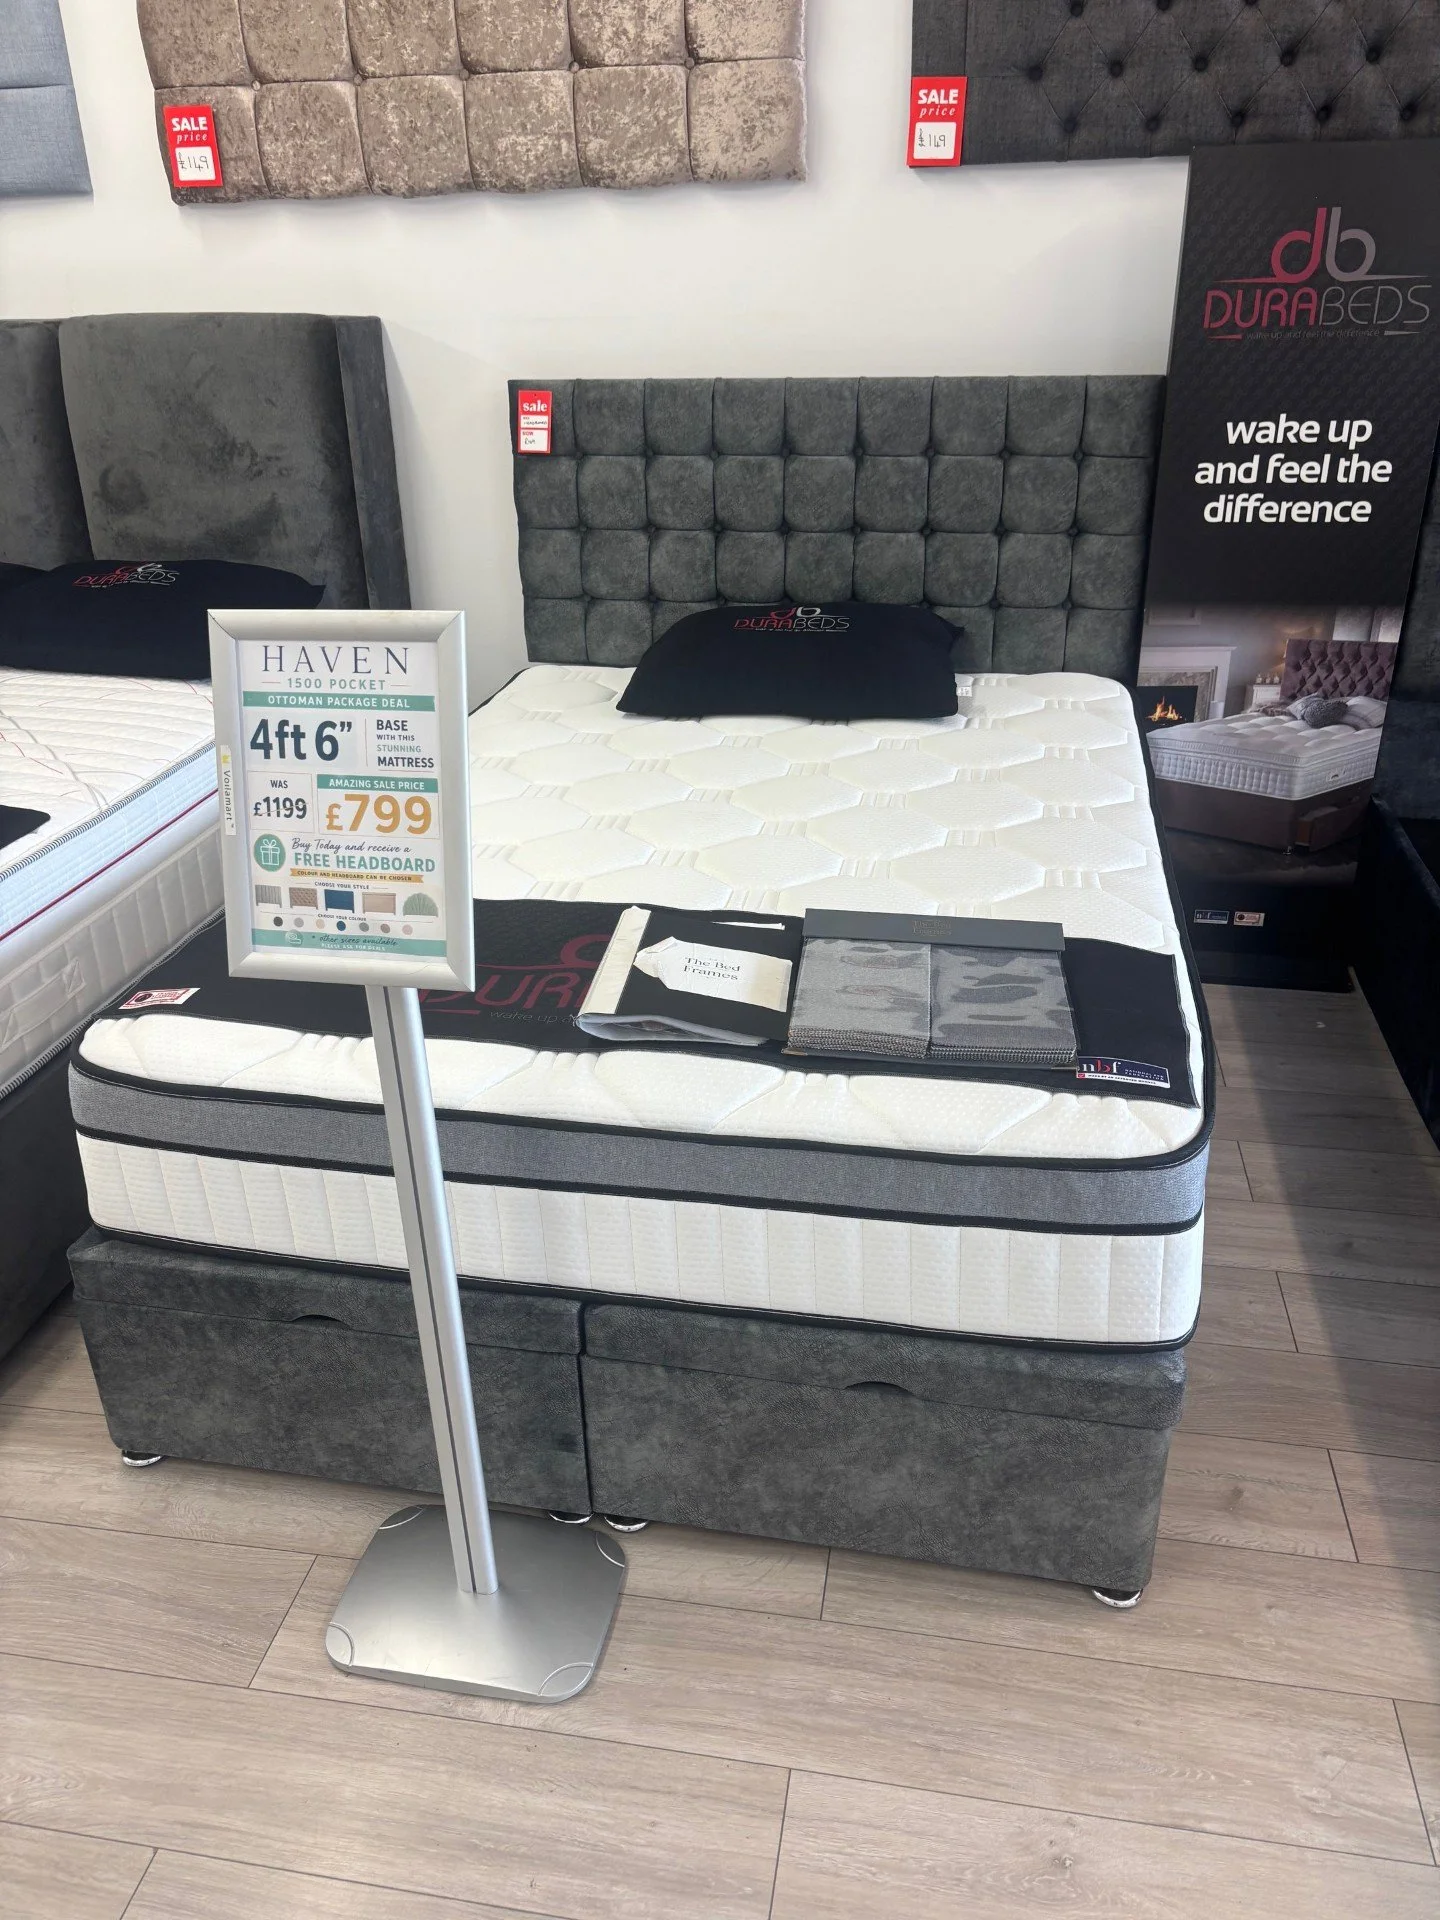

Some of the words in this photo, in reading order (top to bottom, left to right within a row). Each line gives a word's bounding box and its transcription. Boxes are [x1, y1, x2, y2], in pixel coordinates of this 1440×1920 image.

[918, 89, 959, 105] SALE
[919, 105, 956, 118] price
[171, 116, 208, 132] SALE
[176, 132, 208, 144] price
[178, 151, 210, 172] £149
[1203, 284, 1432, 329] DURABEDS
[522, 399, 548, 412] sale
[1226, 413, 1321, 444] wake
[1328, 419, 1373, 450] up
[1194, 454, 1260, 484] and
[1265, 453, 1331, 484] feel
[1336, 453, 1393, 483] the
[1203, 493, 1372, 523] difference
[734, 617, 850, 629] DURABEDS
[262, 645, 410, 675] HAVEN
[287, 678, 322, 689] 1500
[330, 679, 386, 691] POCKET
[268, 695, 323, 706] OTTOMAN
[327, 696, 378, 707] PACKAGE
[382, 698, 410, 708] DEAL
[376, 719, 408, 731] BASE
[250, 718, 306, 760] 4ft
[376, 744, 422, 753] STUNNING
[378, 756, 434, 768] MATTRESS
[270, 779, 288, 789] WAS
[329, 778, 371, 789] AMAZING
[373, 780, 396, 789] SALE
[398, 781, 425, 790] PRICE
[253, 796, 308, 819] £1199
[326, 793, 432, 835] £799
[291, 837, 312, 850] Buy
[314, 838, 341, 854] Today
[344, 841, 364, 852] and
[368, 843, 401, 853] receive
[294, 852, 330, 868] FREE
[336, 855, 435, 872] HEADBOARD
[320, 934, 337, 943] other
[362, 937, 398, 946] available
[684, 956, 711, 967] The
[715, 962, 741, 972] Bed
[683, 965, 739, 980] Frames
[490, 1011, 533, 1021] wake
[538, 1014, 558, 1023] up
